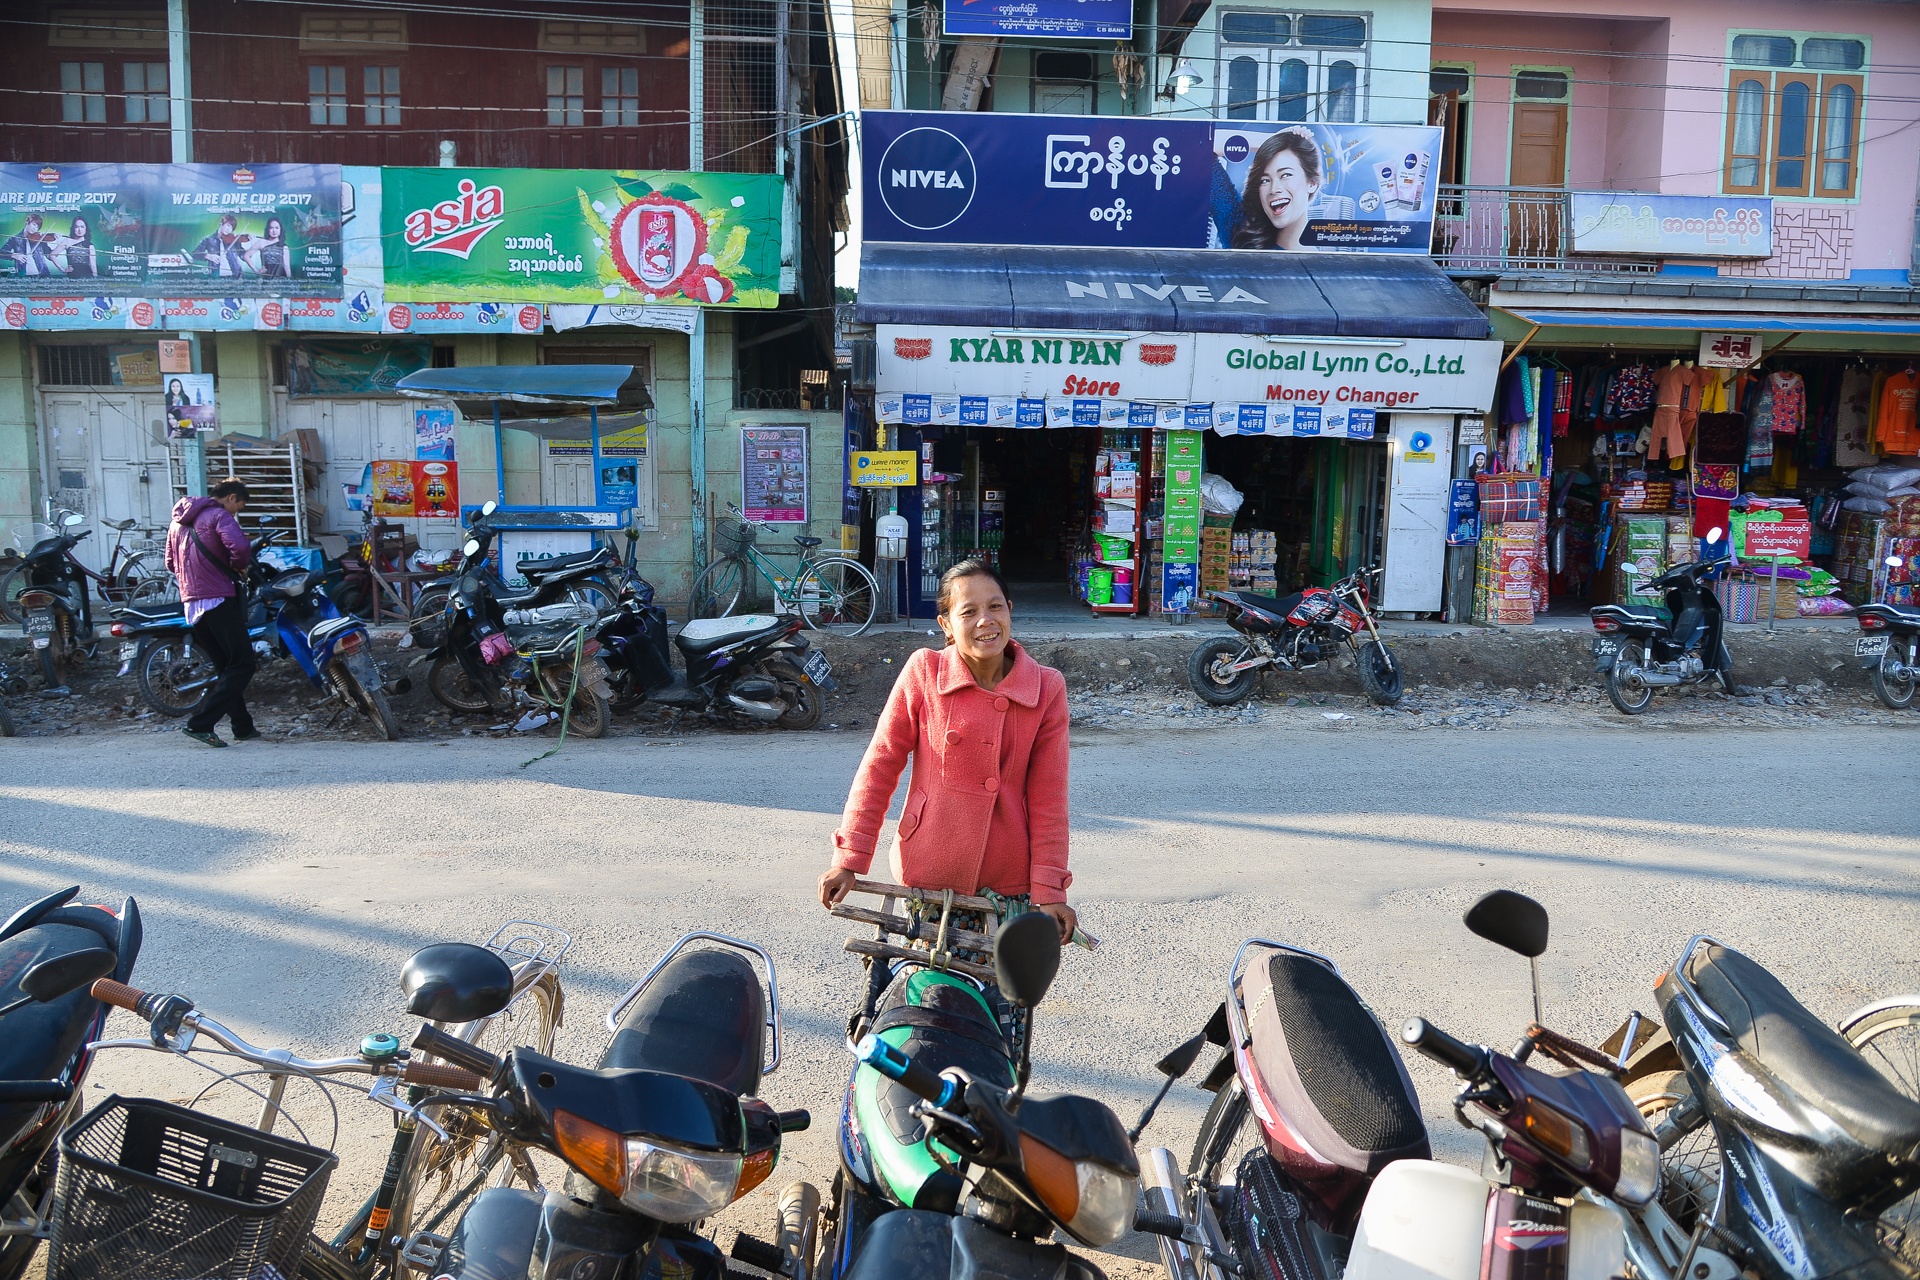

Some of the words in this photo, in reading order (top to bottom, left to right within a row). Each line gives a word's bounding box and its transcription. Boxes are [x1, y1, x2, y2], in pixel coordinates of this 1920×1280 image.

[1044, 134, 1182, 191] ကြာနီပန်း
[892, 168, 964, 188] NIVEA
[27, 193, 52, 204] ONE
[56, 193, 81, 204] CUP
[84, 193, 116, 204] 2017
[172, 193, 191, 204] WE
[193, 193, 218, 204] ARE
[222, 193, 247, 204] ONE
[250, 194, 276, 204] CUP
[279, 194, 312, 205] 2017
[405, 179, 504, 245] asia
[1090, 198, 1132, 230] စတိုး
[1662, 208, 1762, 245] အထည်ဆိုင်
[505, 233, 557, 255] သဘာဝရဲ့
[508, 255, 583, 277] အရသာစစ်စစ်
[1066, 280, 1269, 304] NIVEA
[30, 307, 78, 316] ooredoo
[290, 309, 335, 317] oredoo
[416, 312, 464, 320] ooredoo
[950, 338, 1024, 363] KYAR
[1031, 340, 1062, 364] NI
[1069, 341, 1123, 366] PAN
[1226, 348, 1305, 370] Global
[1313, 351, 1369, 377] Lynn
[1376, 352, 1466, 377] Co.,Ltd.
[1062, 374, 1120, 396] Store
[1266, 385, 1330, 405] Money
[1336, 386, 1419, 406] Changer
[1526, 1198, 1561, 1214] HONDA
[1508, 1220, 1568, 1232] Dream
